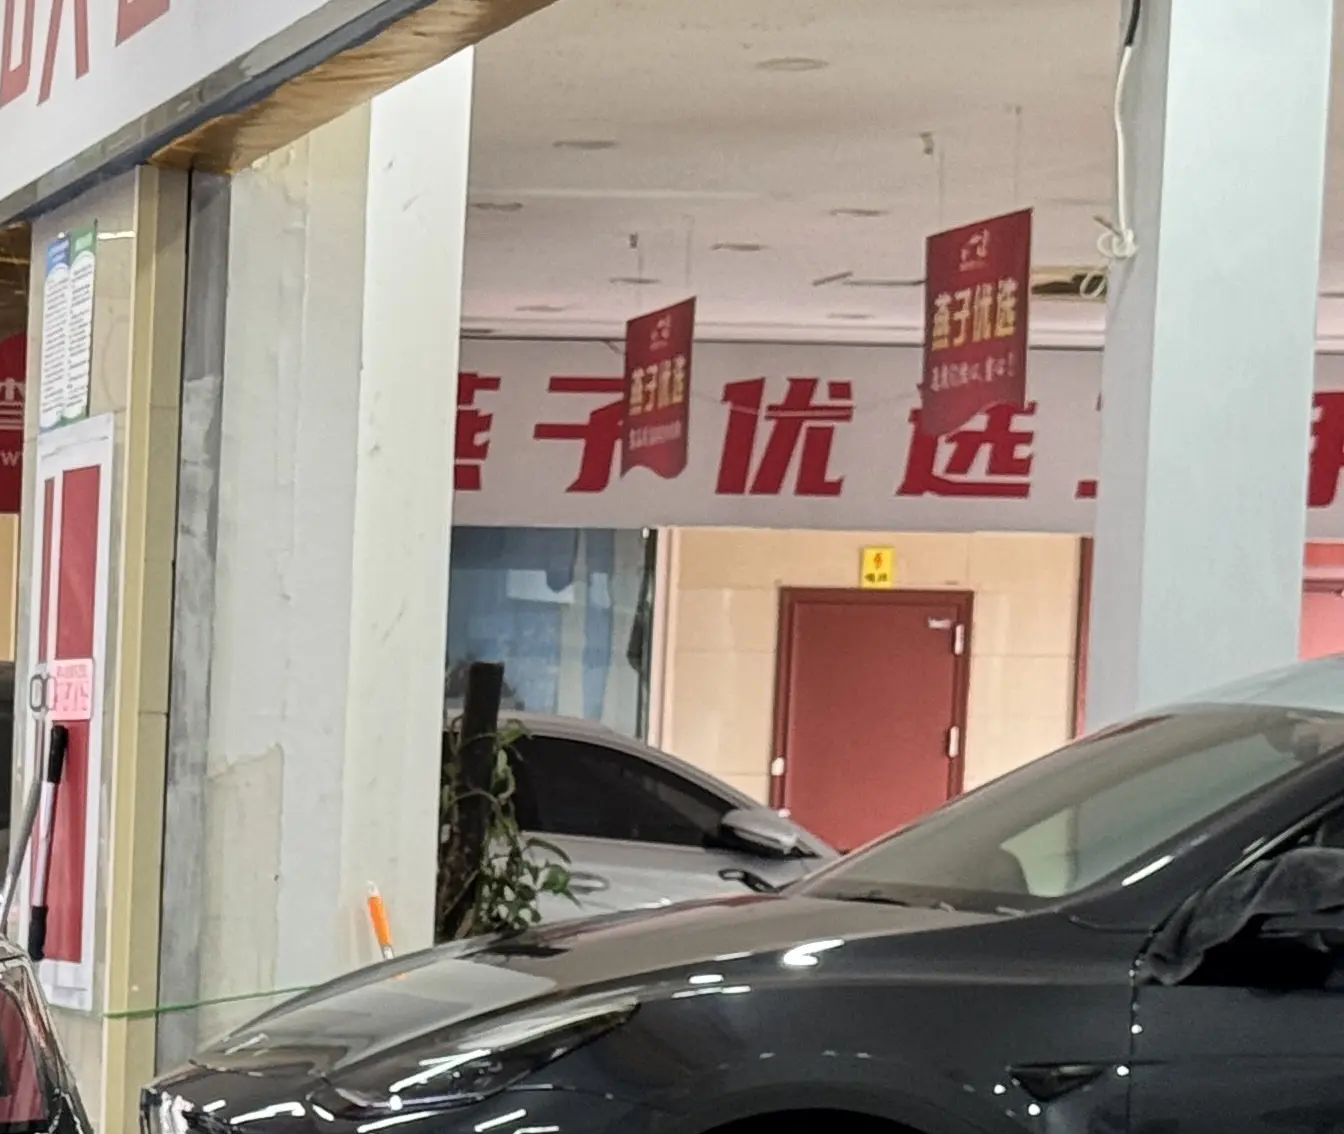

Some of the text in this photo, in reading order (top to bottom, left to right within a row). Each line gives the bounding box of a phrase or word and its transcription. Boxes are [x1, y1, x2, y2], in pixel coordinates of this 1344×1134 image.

[931, 278, 1018, 350] 燕子优选
[629, 356, 686, 416] 燕子优选
